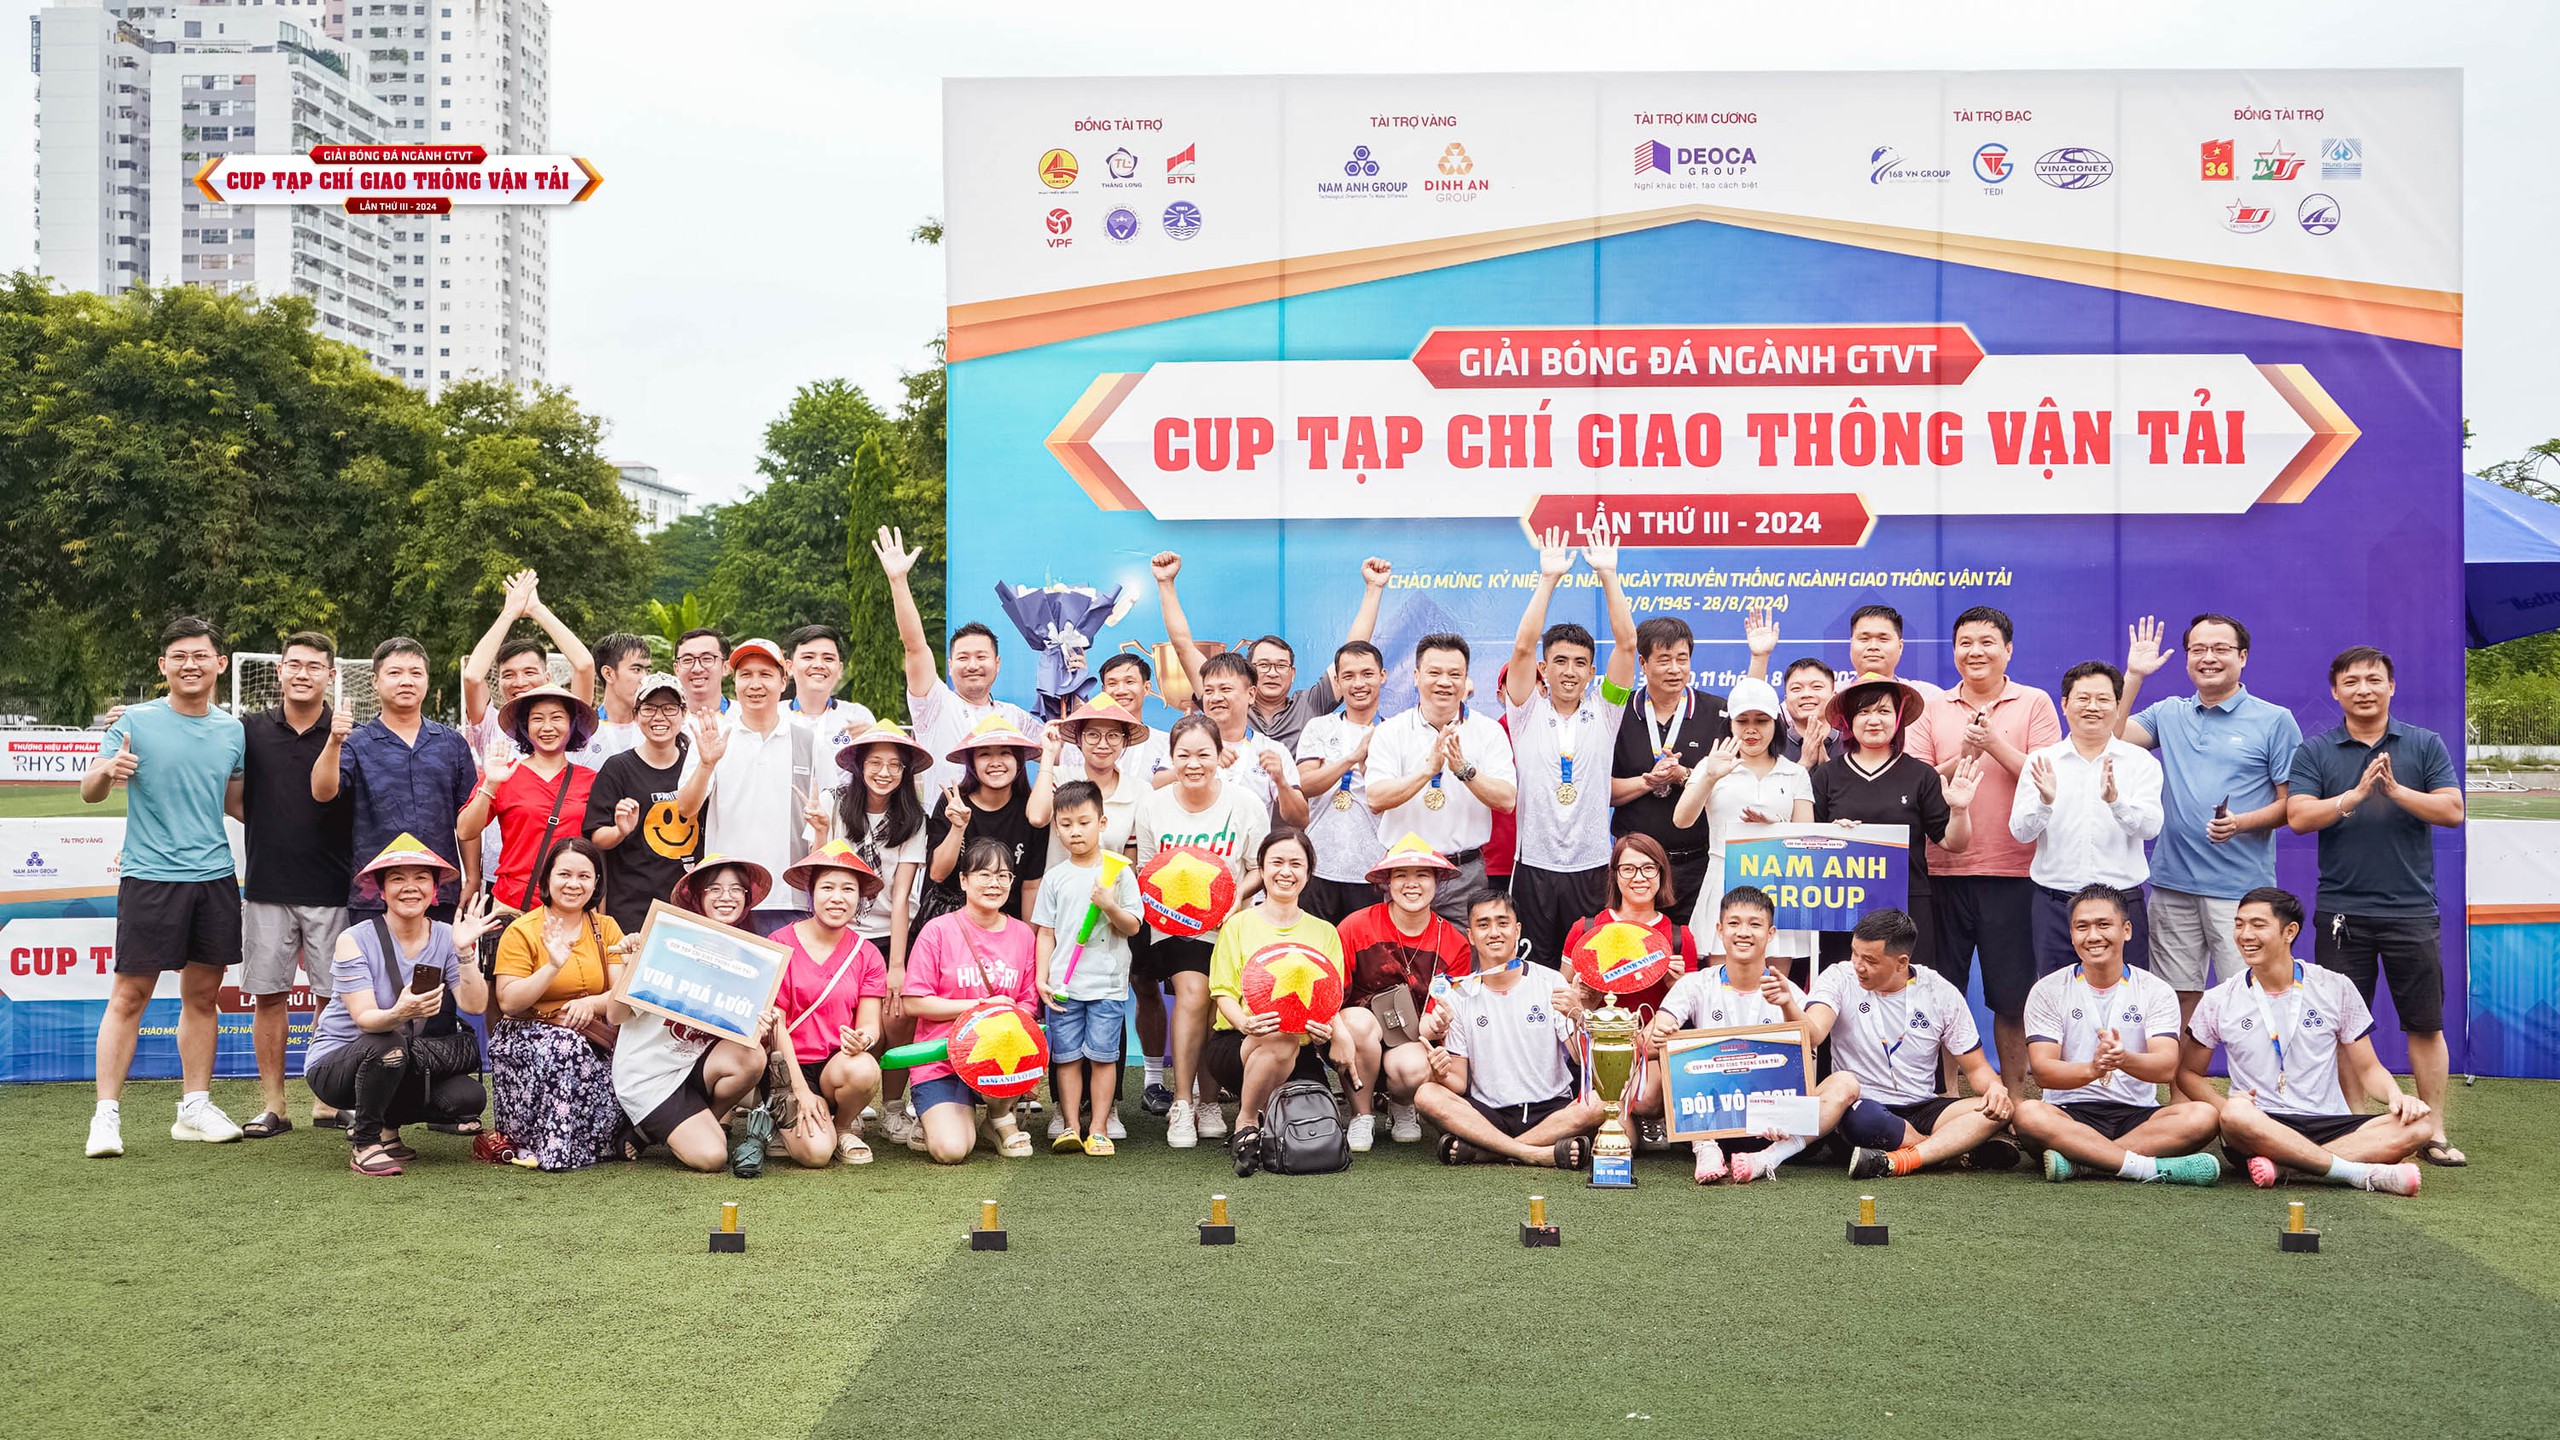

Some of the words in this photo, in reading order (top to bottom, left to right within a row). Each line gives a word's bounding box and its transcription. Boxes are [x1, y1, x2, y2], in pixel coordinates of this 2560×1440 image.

[1370, 114, 1390, 127] TÀI
[1393, 116, 1419, 129] TRỢ
[1421, 114, 1457, 127] VÀNG
[1634, 112, 1654, 124] TÀI
[1656, 112, 1683, 126] TRỢ
[1686, 113, 1708, 124] KIM
[1711, 112, 1757, 124] CƯƠNG
[1953, 108, 1973, 122] TÀI
[1976, 109, 2003, 124] TRỢ
[2005, 110, 2032, 123] BẠC
[2234, 105, 2272, 121] ĐỒNG
[2274, 107, 2294, 120] TÀI
[2297, 108, 2325, 122] TRỢ
[1074, 116, 1111, 131] ĐỒNG
[1114, 117, 1133, 131] TÀI
[1136, 118, 1163, 132] TRỢ
[1677, 147, 1757, 165] DEOCA
[1688, 167, 1747, 176] GROUP
[1920, 170, 1951, 178] GROUP
[2041, 165, 2108, 173] VINACONEX
[2205, 162, 2229, 176] 36
[1167, 176, 1195, 184] BTN
[1318, 182, 1343, 193] NAM
[1345, 182, 1369, 192] ANH
[1372, 182, 1408, 192] GROUP
[1424, 180, 1463, 191] DINH
[1468, 180, 1489, 190] AN
[1436, 193, 1477, 202] GROUP
[1984, 188, 2004, 196] TEDI
[1047, 238, 1073, 248] VPF
[1460, 337, 1530, 378] GIẢI
[1542, 339, 1638, 376] BÓNG
[1649, 339, 1698, 375] ĐÁ
[1708, 338, 1836, 375] NGÀNH
[1847, 344, 1937, 374] GTVT
[1153, 417, 1275, 472] CUP
[1297, 415, 1424, 485] TẠP
[1447, 398, 1553, 468] CHÍ
[1578, 412, 1722, 468] GIAO
[1747, 396, 1964, 467] THÔNG
[1987, 395, 2113, 480] VẬN
[2137, 388, 2246, 465] TẢI
[1576, 501, 1631, 535] LẦN
[1638, 505, 1696, 534] THỨ
[1703, 511, 1729, 534] III
[1755, 510, 1822, 534] 2024
[1388, 573, 1431, 588] CHÀO
[1433, 572, 1483, 589] MỪNG
[1488, 570, 1510, 588] KỶ
[1511, 570, 1542, 592] NIỆ
[1575, 573, 1603, 588] NĂ
[1664, 566, 1728, 588] TRUYỀN
[1730, 567, 1786, 588] THỐNG
[1787, 570, 1846, 588] NGÀNH
[1848, 573, 1888, 587] GIAO
[1890, 569, 1946, 587] THÔNG
[1948, 568, 1986, 589] VẬN
[1987, 567, 2013, 586] TẢI
[16, 755, 65, 772] RHYS
[1160, 824, 1236, 857] GUCCI
[1740, 855, 1814, 878] NAM
[1822, 856, 1886, 879] ANH
[1762, 885, 1865, 909] GROUP
[11, 947, 77, 977] CUP
[643, 967, 673, 991] VUA
[677, 978, 710, 1003] PHÁ
[1681, 1092, 1714, 1117] ĐỘI
[1719, 1089, 1745, 1112] VÔ
